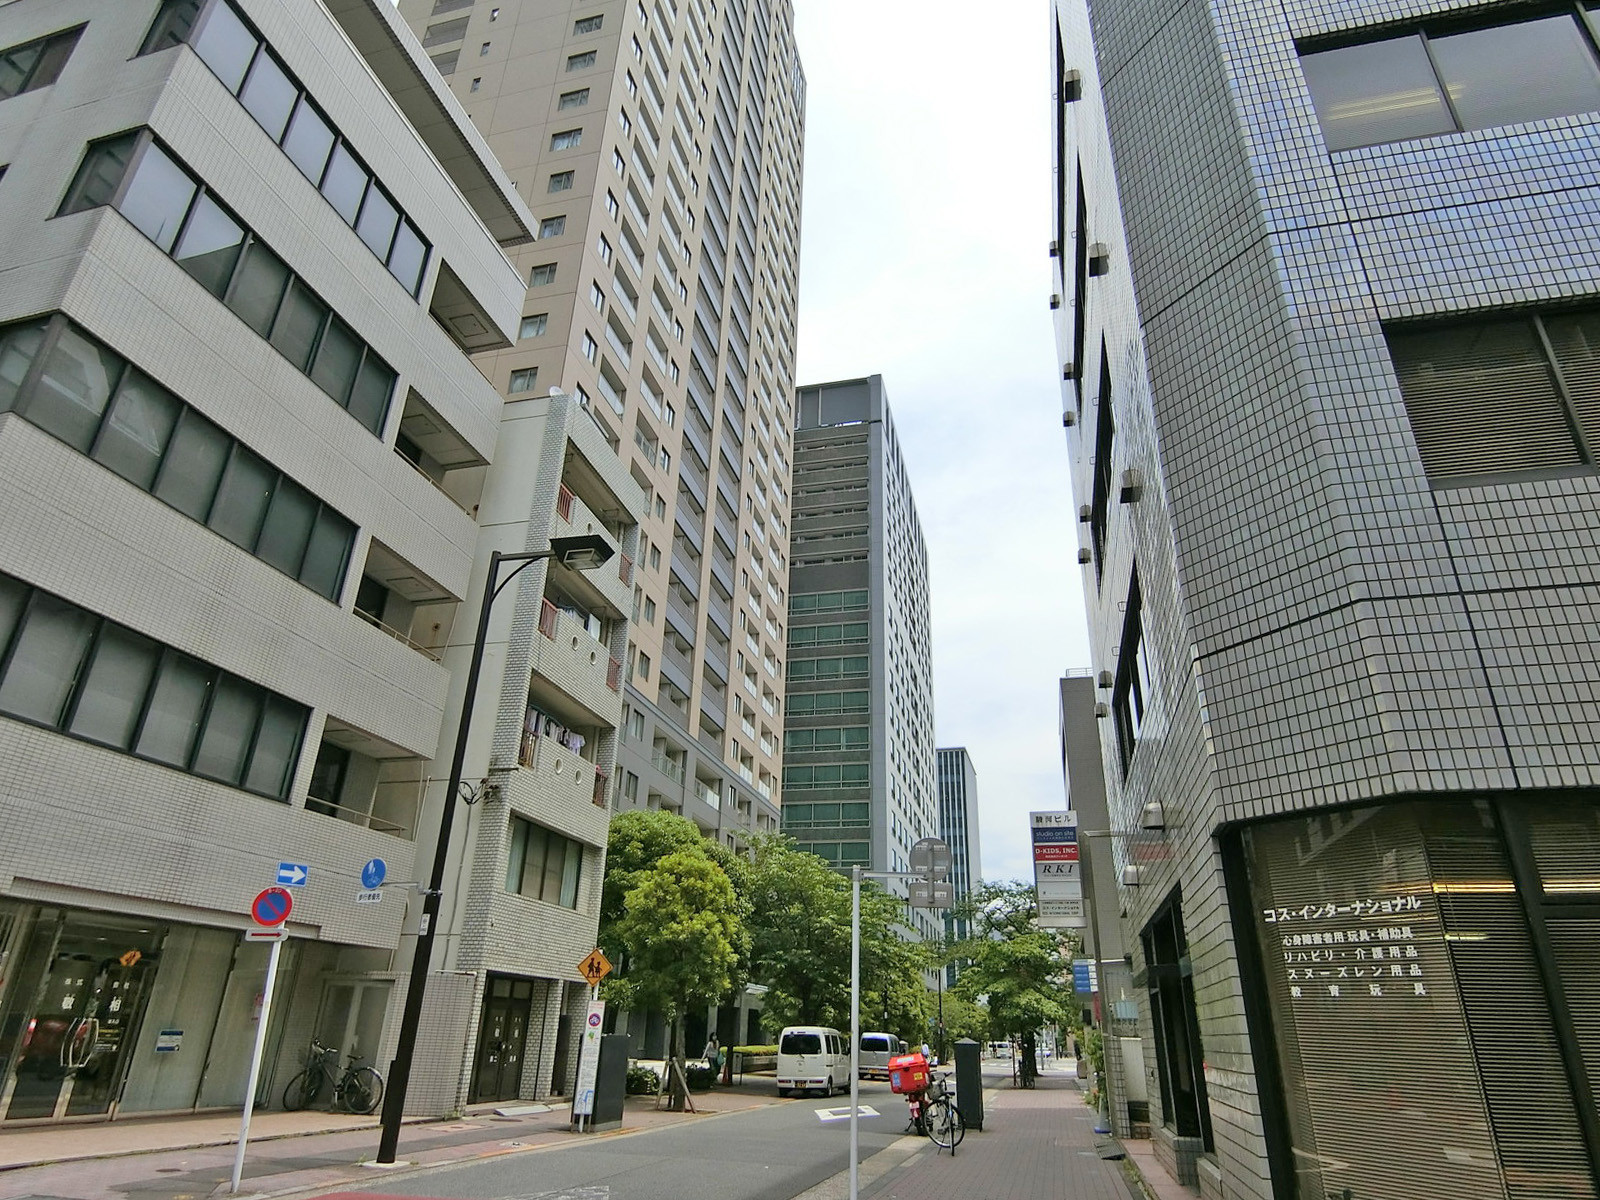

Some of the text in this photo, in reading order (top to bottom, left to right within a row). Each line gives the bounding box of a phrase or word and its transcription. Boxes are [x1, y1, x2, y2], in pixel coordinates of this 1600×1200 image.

[1263, 895, 1421, 922] コス・インターナショナル
[1284, 945, 1418, 963] リハビリ・介護用品
[1288, 964, 1422, 979] スヌーズレン用品
